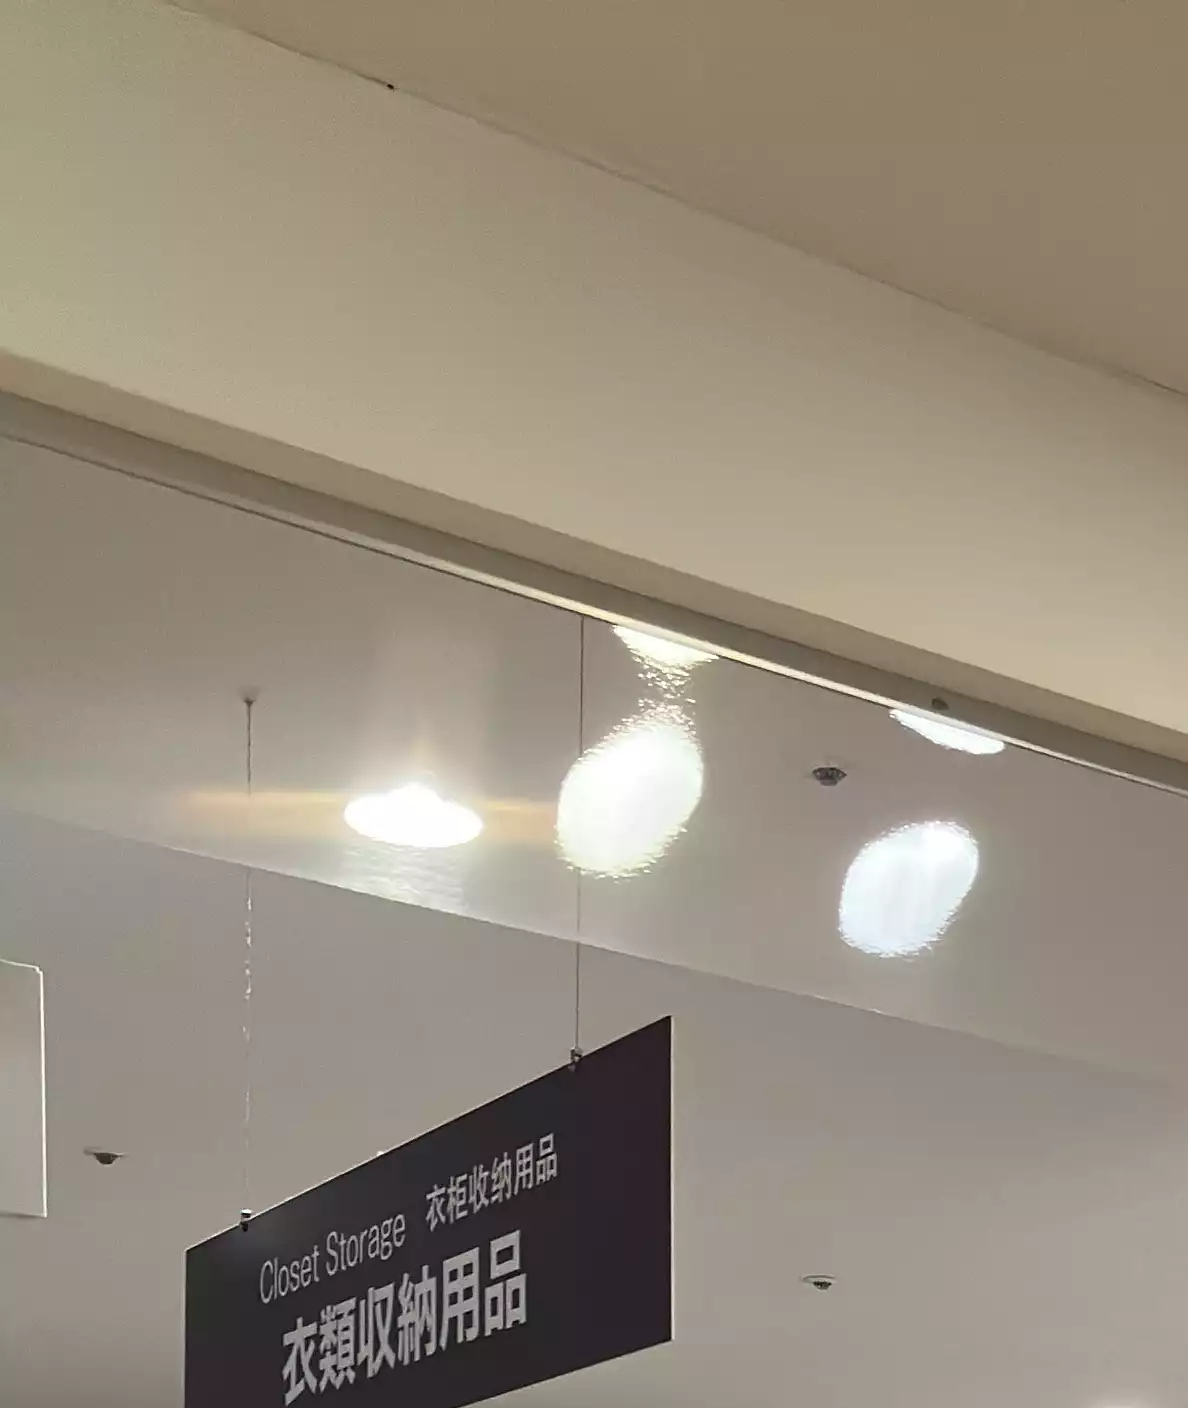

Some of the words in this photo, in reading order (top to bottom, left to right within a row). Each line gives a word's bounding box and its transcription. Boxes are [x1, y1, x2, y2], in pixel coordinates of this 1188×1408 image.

[425, 1132, 559, 1234] 衣柜收纳用品
[259, 1247, 320, 1305] Closet
[325, 1213, 407, 1277] Storage
[282, 1229, 528, 1407] 衣類収納用品
